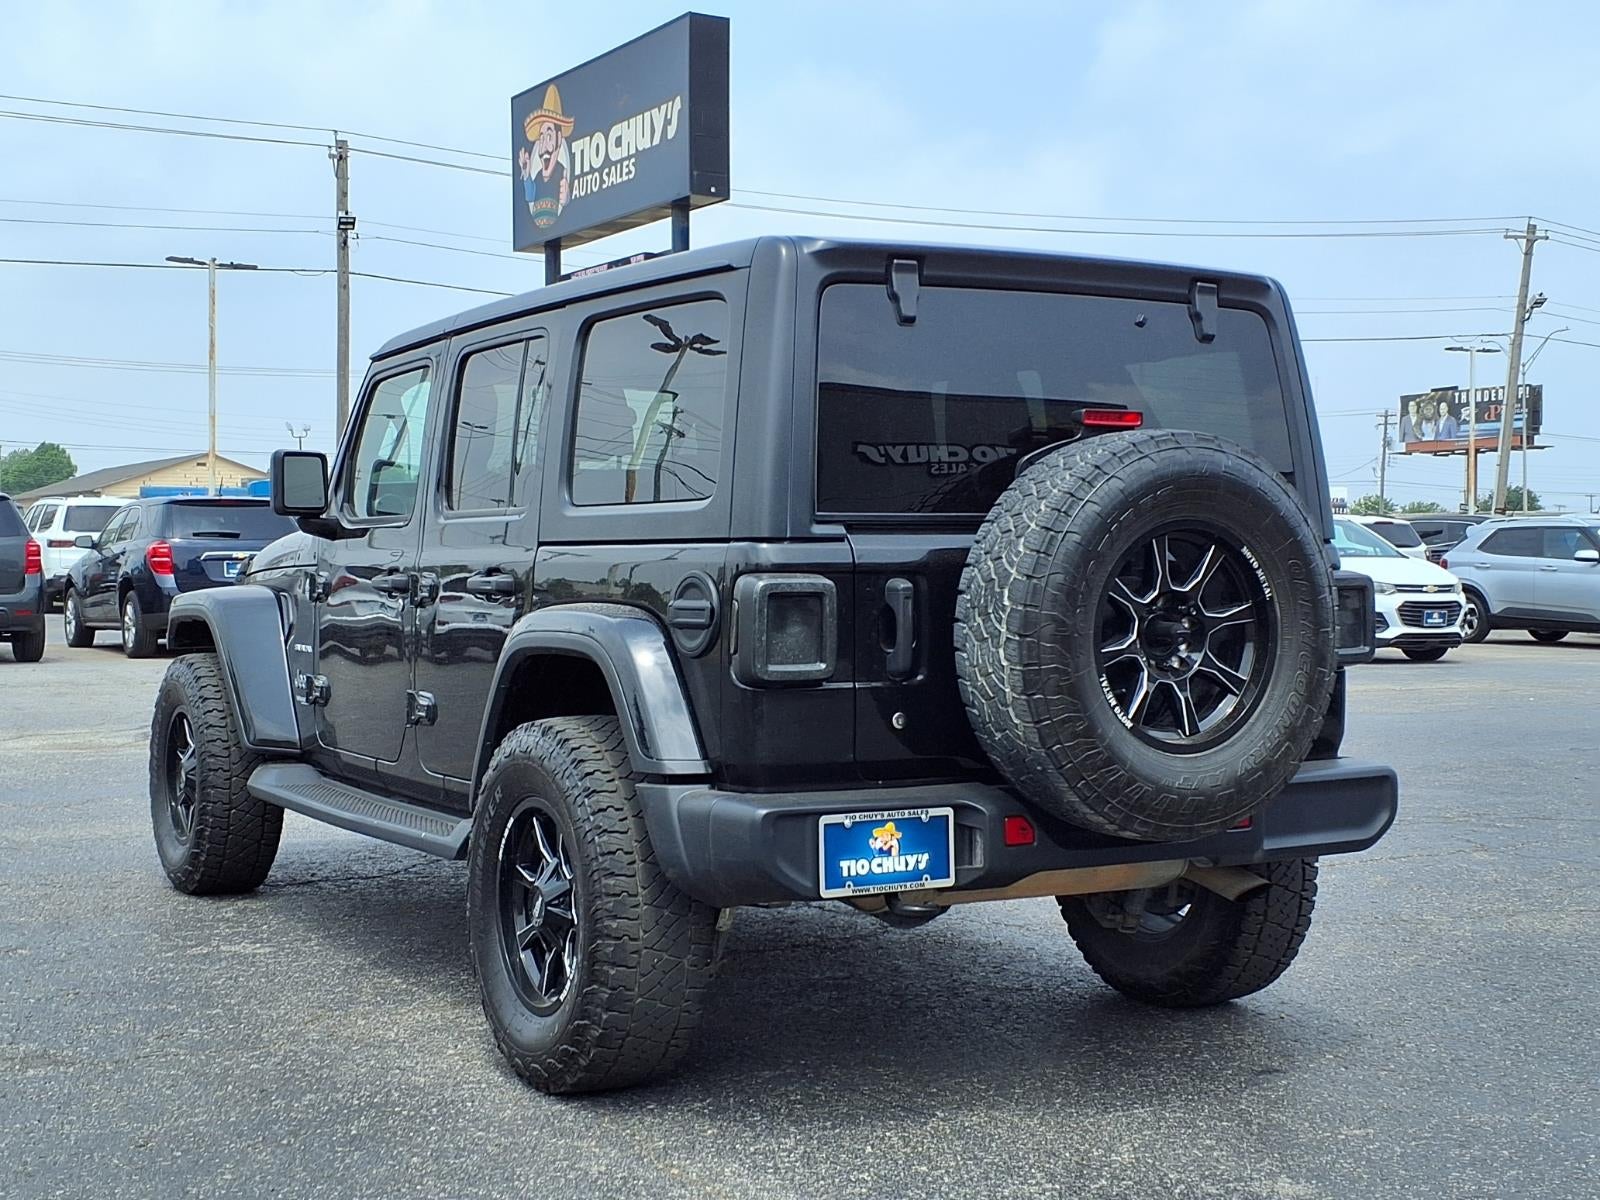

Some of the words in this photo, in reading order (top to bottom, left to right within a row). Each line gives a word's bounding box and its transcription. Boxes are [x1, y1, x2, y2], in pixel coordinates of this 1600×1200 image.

[572, 131, 606, 176] TIO
[607, 95, 681, 162] CHUY'S
[572, 171, 600, 200] AUTO
[602, 157, 636, 189] SALES
[1454, 388, 1505, 404] THNDER
[1240, 545, 1259, 569] MOTO
[1255, 568, 1272, 601] METAL
[1099, 673, 1118, 707] METAL
[1113, 705, 1134, 730] MOTO
[886, 810, 906, 818] AUTO
[840, 859, 870, 878] TIO
[870, 852, 929, 874] CHUY'S
[851, 882, 926, 894] WWW.TIOCHUYS.COM
